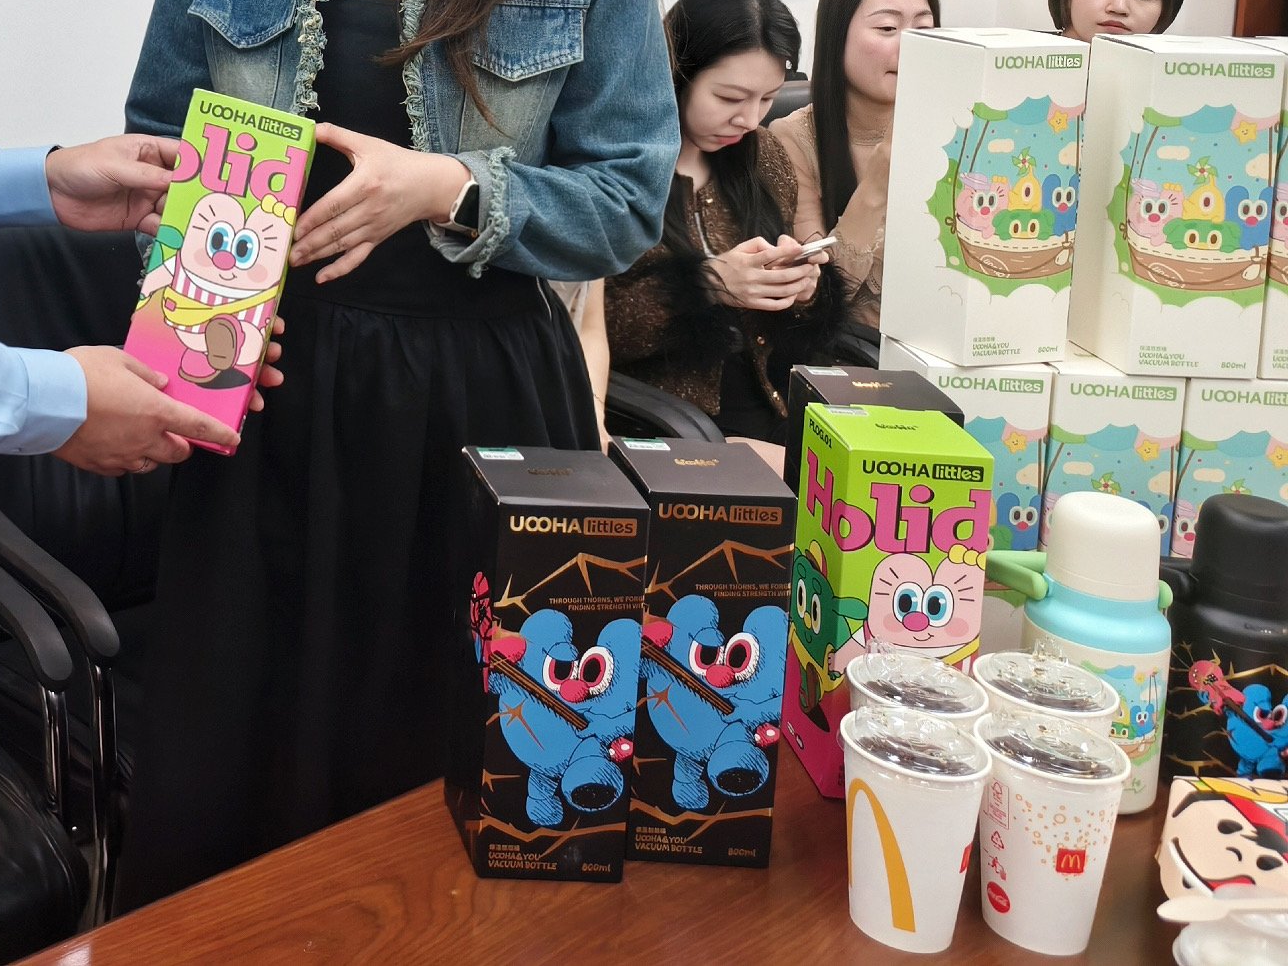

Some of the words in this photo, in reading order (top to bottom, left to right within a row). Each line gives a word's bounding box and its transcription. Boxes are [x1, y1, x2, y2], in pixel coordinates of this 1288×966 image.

[994, 55, 1044, 69] UOOHA
[1047, 54, 1081, 69] littles
[1164, 61, 1226, 77] UOOHA
[1231, 63, 1272, 78] littles
[199, 99, 257, 129] UOOHA
[259, 115, 301, 140] littles
[972, 349, 998, 357] VACUUM
[998, 348, 1021, 356] BOTTLE
[1037, 344, 1059, 353] 800ml
[1138, 359, 1171, 368] VACUUM
[1171, 360, 1199, 368] BOTTLE
[1220, 361, 1247, 370] 800ml
[938, 375, 998, 391] UOOHA
[1001, 379, 1042, 394] littles
[1070, 382, 1131, 398] UOOHA
[1134, 387, 1176, 401] littles
[1201, 389, 1261, 404] UOOHA
[862, 459, 931, 478] UOOHA
[934, 465, 982, 481] littles
[658, 502, 728, 522] UOOHA
[733, 507, 779, 523] littles
[509, 515, 582, 534] UOOHA
[587, 519, 634, 534] littles
[695, 583, 728, 591] THROUGH
[549, 597, 582, 605] THROUGH
[635, 842, 670, 852] VACUUM
[670, 844, 703, 854] BOTTLE
[488, 860, 524, 870] VACUUM
[524, 861, 557, 870] BOTTLE
